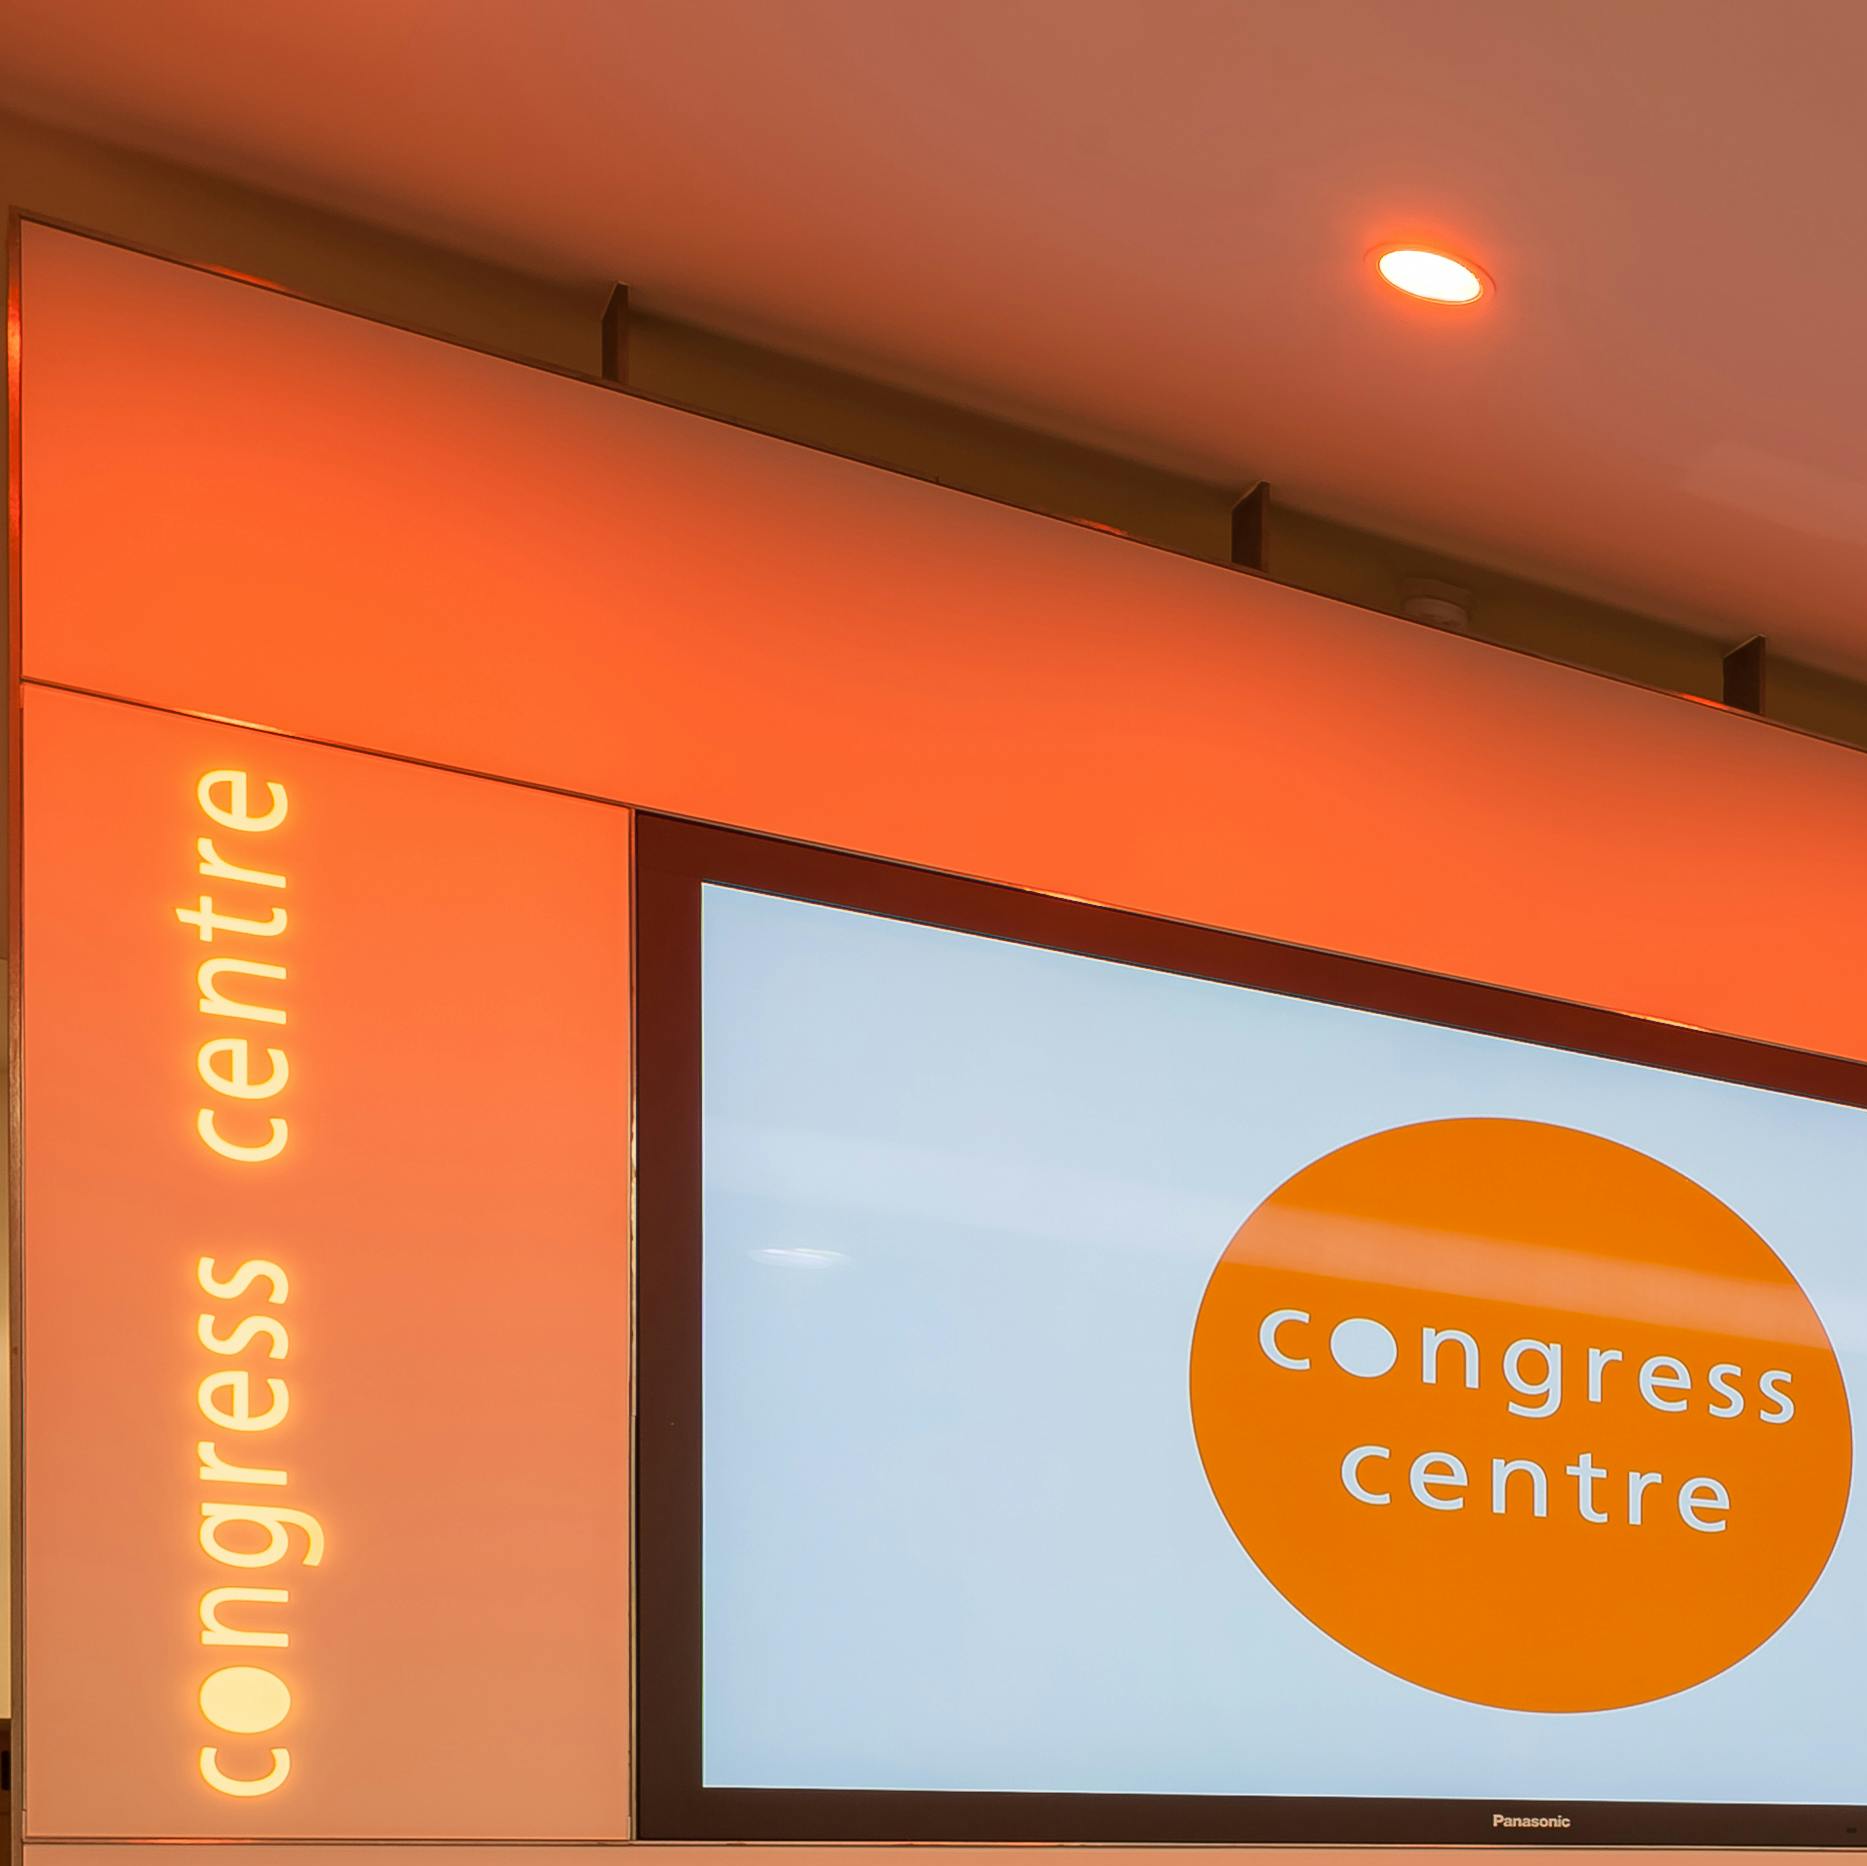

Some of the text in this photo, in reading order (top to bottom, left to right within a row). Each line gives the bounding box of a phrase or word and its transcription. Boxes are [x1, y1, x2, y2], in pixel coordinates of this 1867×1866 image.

[175, 768, 325, 1798] congress centre
[1257, 1308, 1796, 1424] congress
[1340, 1444, 1731, 1533] centre
[1492, 1814, 1571, 1828] Panasonic
